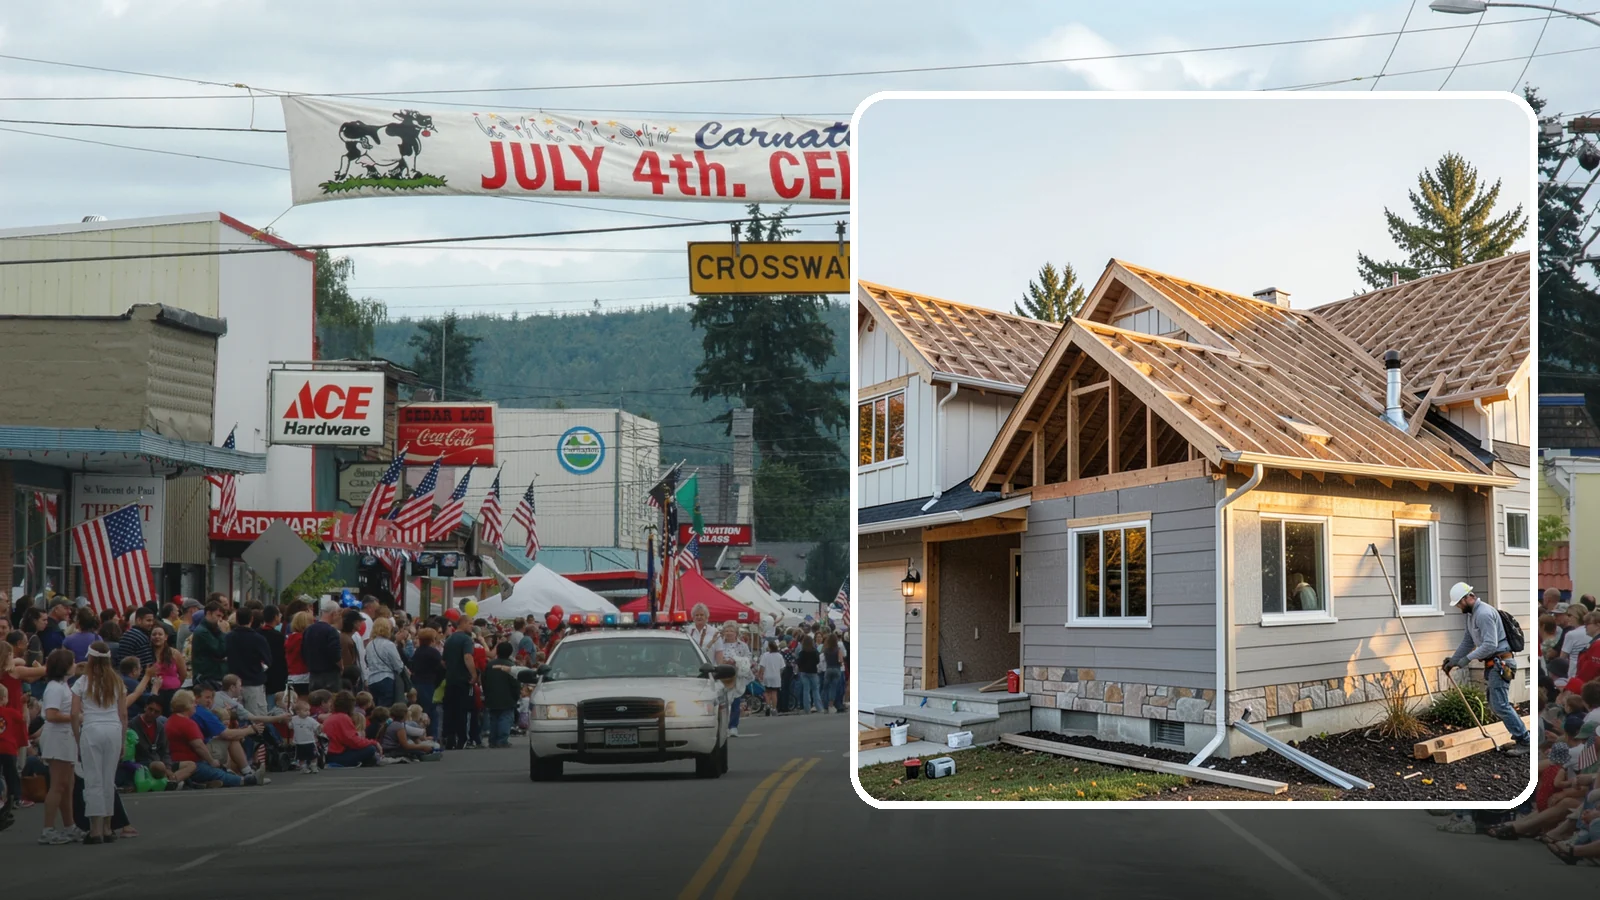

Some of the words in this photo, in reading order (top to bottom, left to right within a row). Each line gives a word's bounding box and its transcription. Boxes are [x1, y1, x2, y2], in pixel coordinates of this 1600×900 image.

[481, 141, 605, 193] JULY
[632, 150, 747, 198] 4th.
[697, 254, 850, 280] CROSSWA
[283, 380, 373, 420] ACE
[283, 421, 371, 436] Hardware
[416, 426, 477, 447] Coca-Cola
[353, 467, 385, 483] Simpl
[95, 485, 124, 495] Vincent
[126, 486, 136, 495] de
[137, 486, 155, 495] Paul
[688, 526, 741, 535] CRNATION
[699, 535, 730, 543] GLASS
